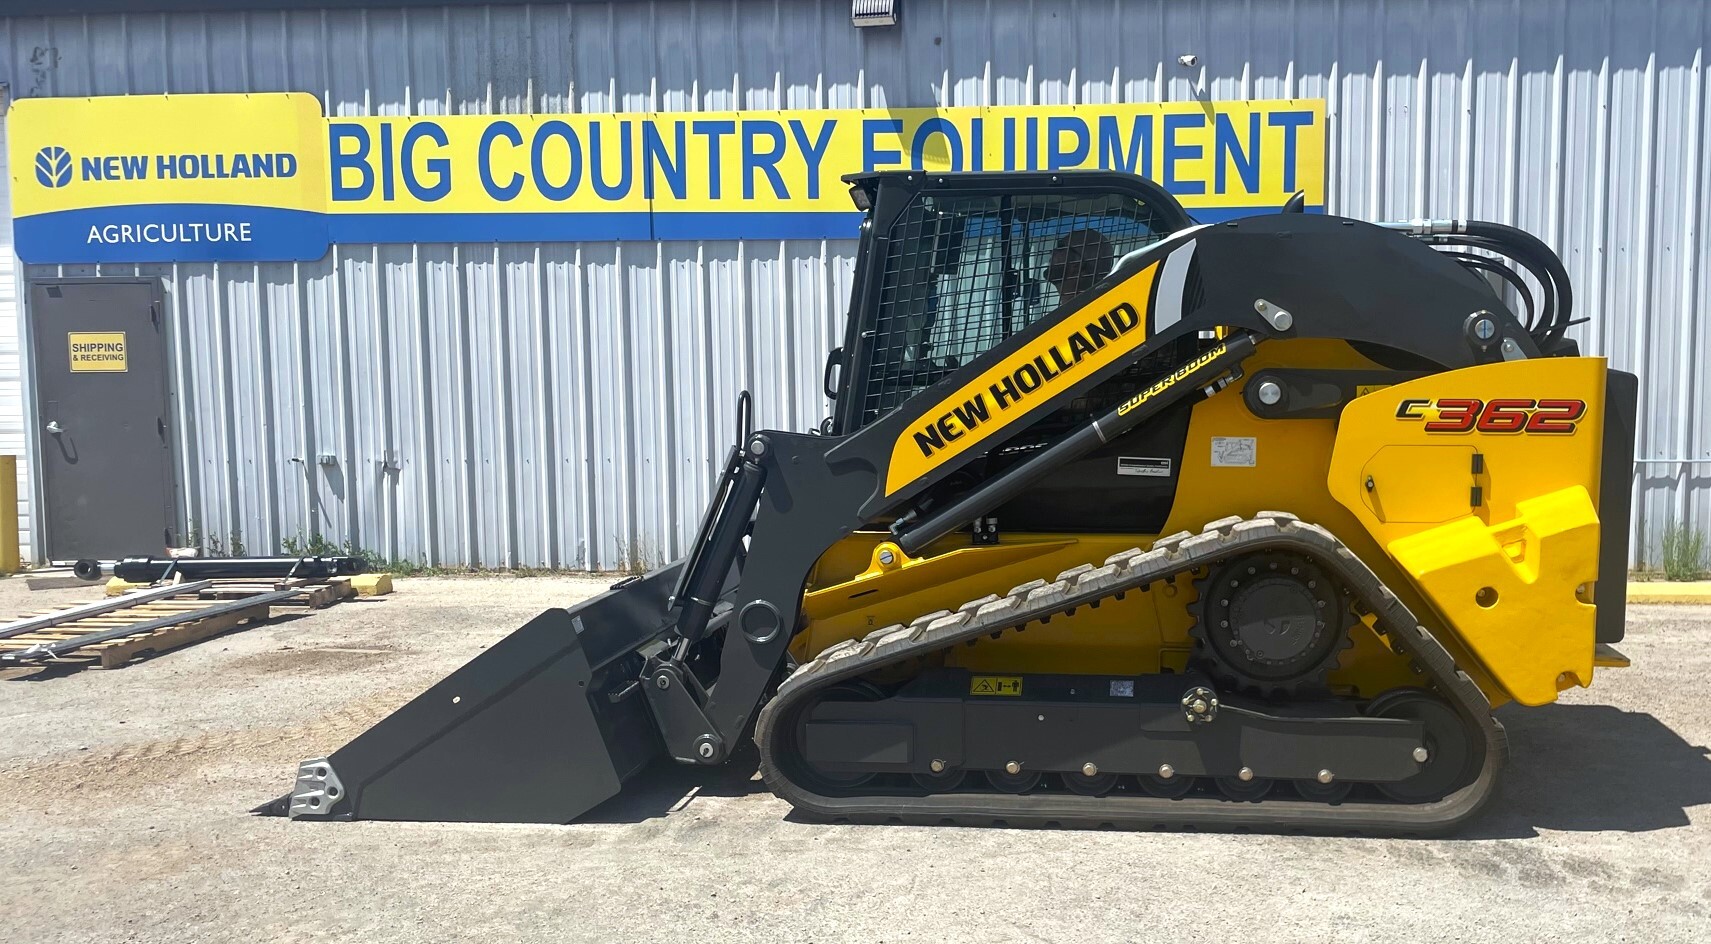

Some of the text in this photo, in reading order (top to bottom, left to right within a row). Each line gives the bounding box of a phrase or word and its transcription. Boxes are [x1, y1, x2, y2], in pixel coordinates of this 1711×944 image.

[81, 153, 297, 181] NEW HOLLAND
[328, 110, 1314, 202] BIG COUNTRY EQUIPMENT
[87, 222, 252, 244] AGRICULTURE
[72, 343, 124, 352] SHIPPING
[912, 302, 1140, 459] NEW HOLLAND
[1118, 343, 1227, 416] SUPER BOOM
